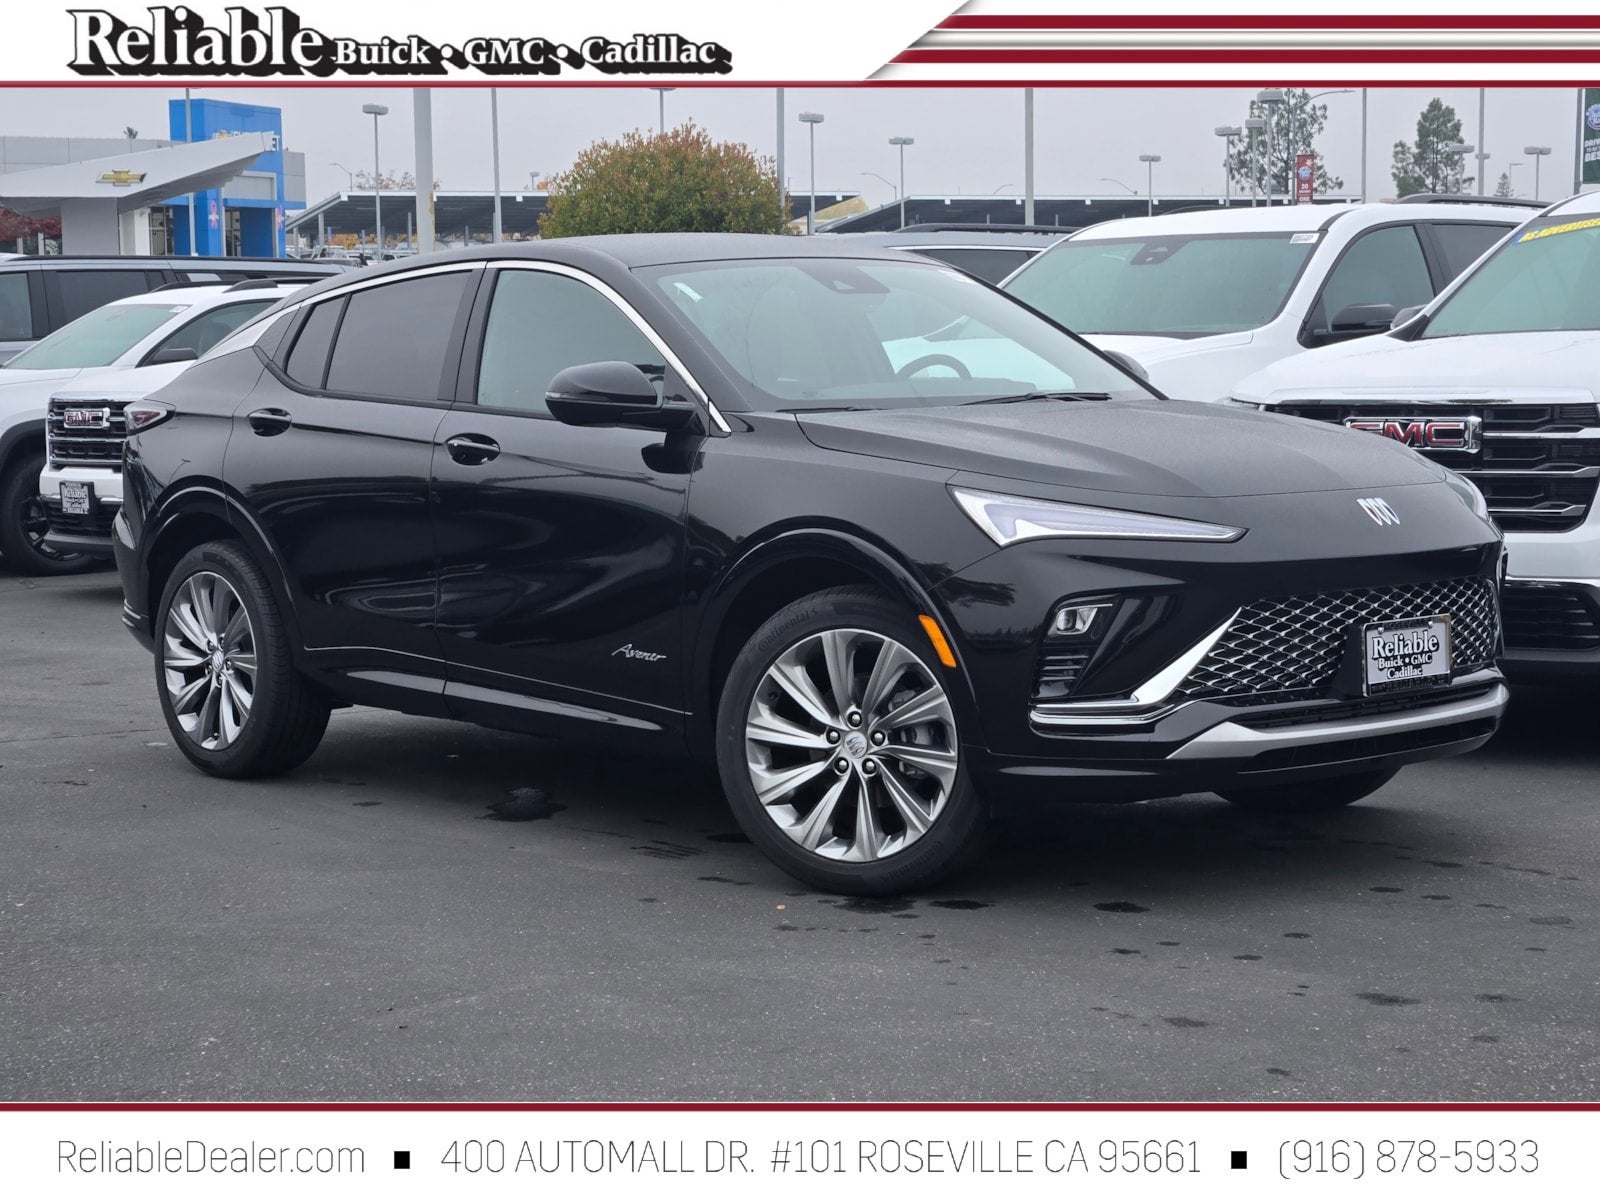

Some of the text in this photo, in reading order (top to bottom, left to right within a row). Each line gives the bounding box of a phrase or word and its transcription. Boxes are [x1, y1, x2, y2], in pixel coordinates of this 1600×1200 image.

[65, 411, 103, 426] GMC
[1372, 629, 1440, 660] Reliable
[1378, 652, 1433, 671] Buick GMC
[1387, 665, 1423, 680] Cadillac
